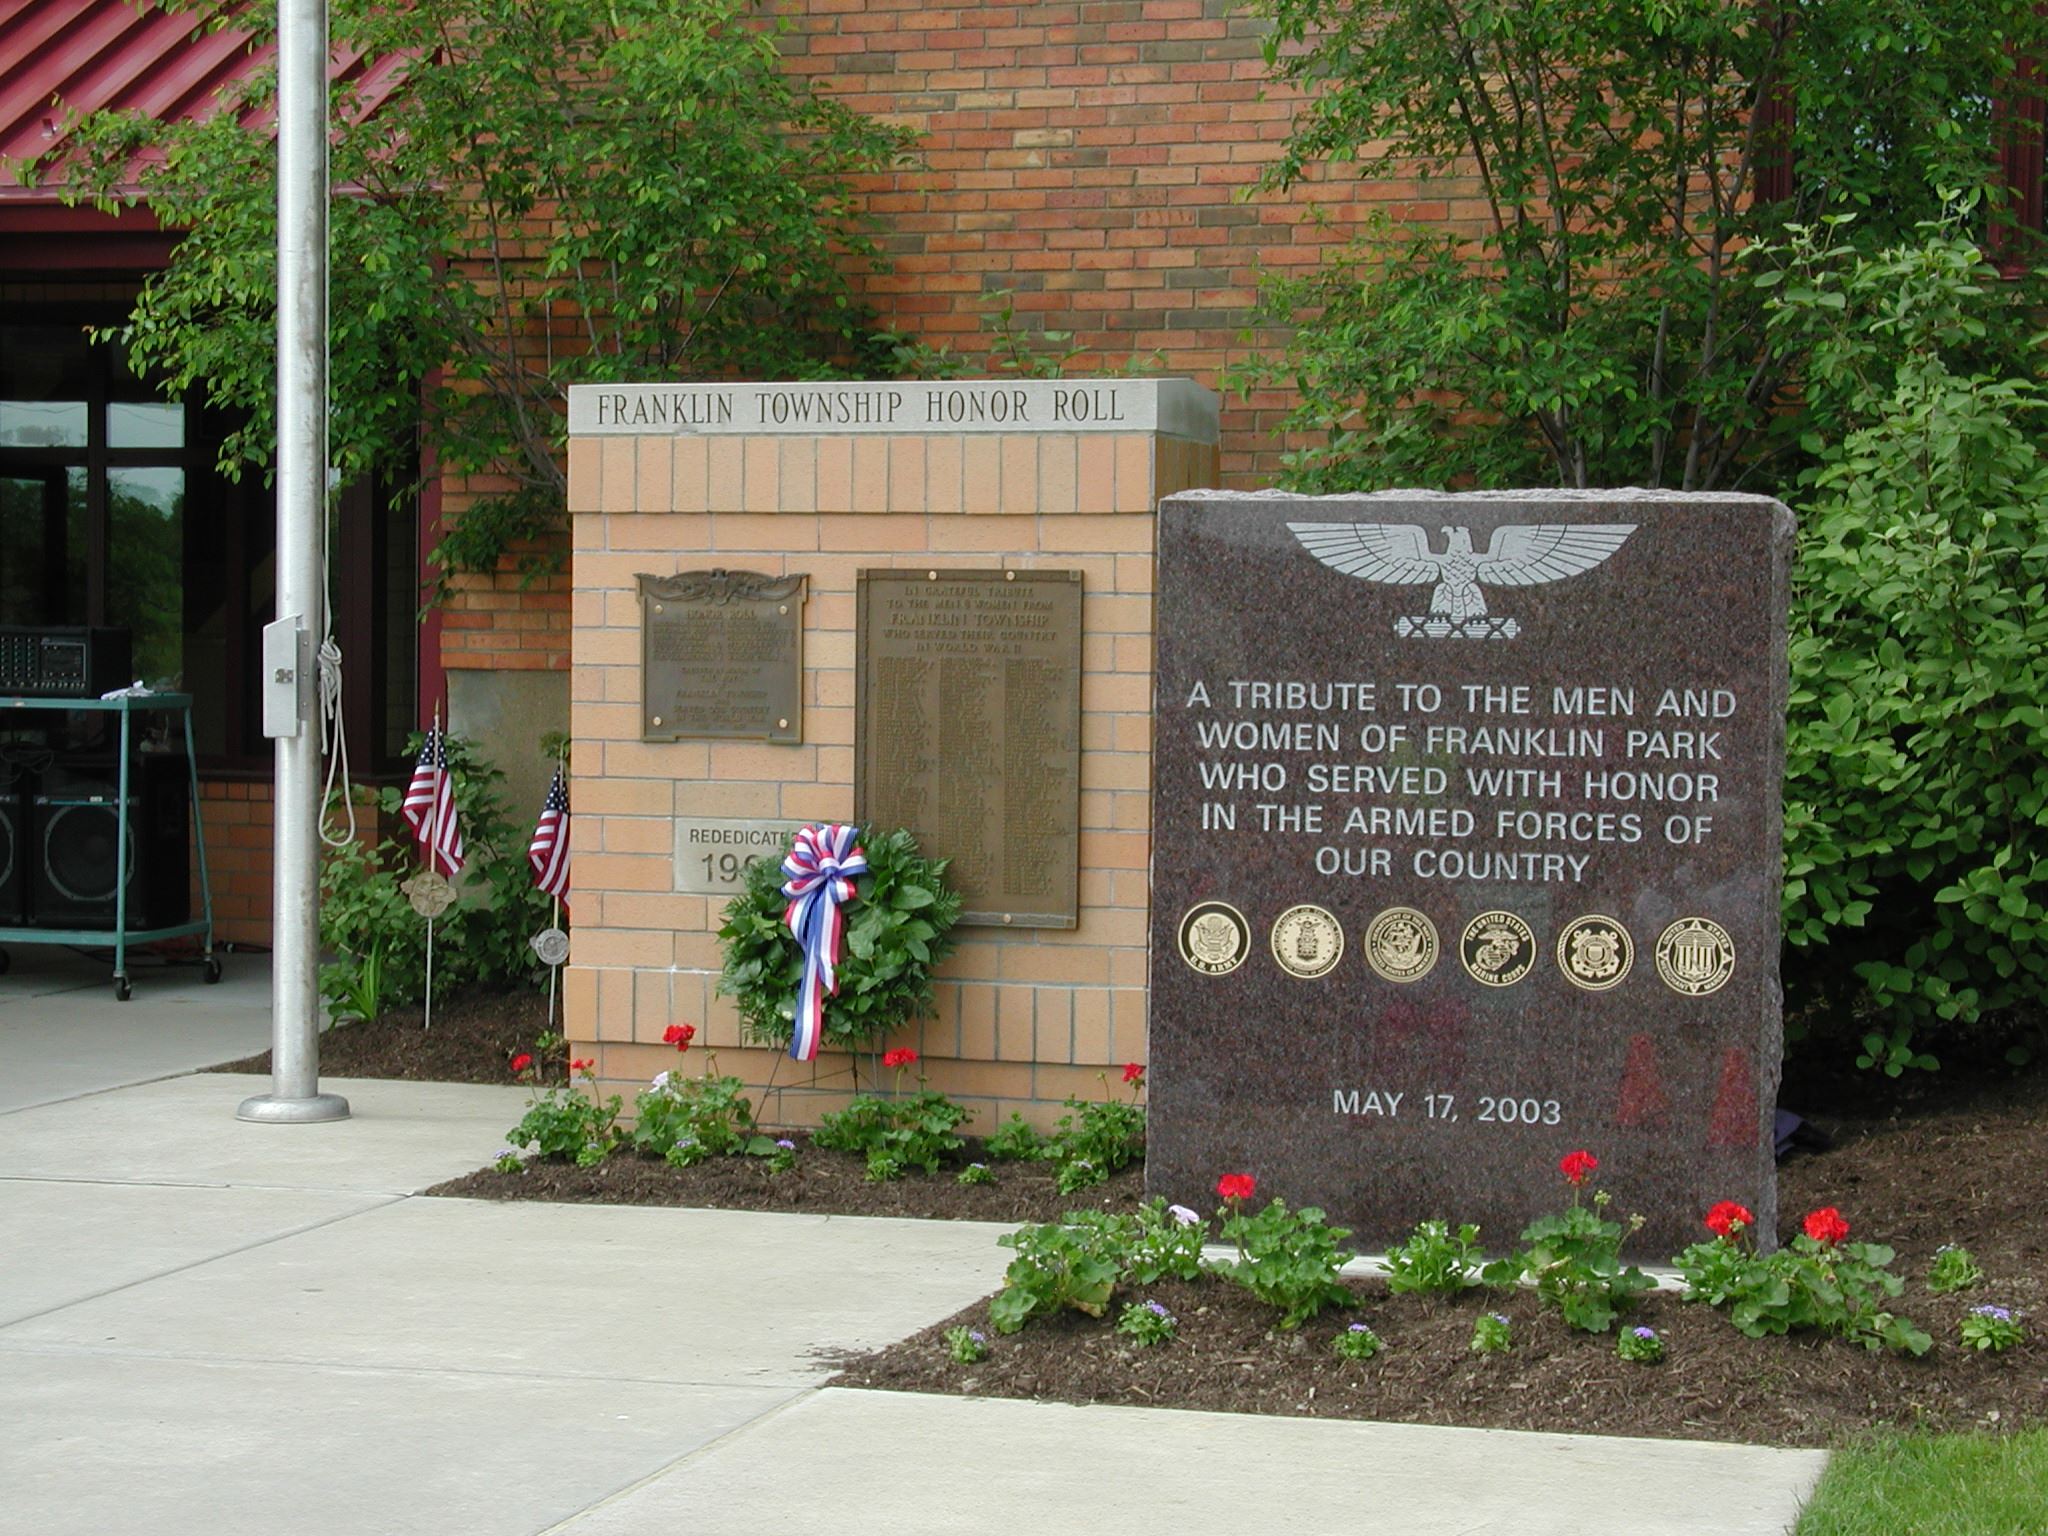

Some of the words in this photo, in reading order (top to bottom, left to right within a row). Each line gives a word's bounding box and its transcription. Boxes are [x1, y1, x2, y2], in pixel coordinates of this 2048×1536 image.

[599, 393, 732, 424] FRANKLIN
[755, 392, 901, 423] TOWNSHIP
[927, 390, 1029, 422] HONOR
[1054, 389, 1124, 421] ROLL
[974, 614, 1050, 628] TOWNSHIP
[1187, 682, 1210, 707] A
[1229, 682, 1375, 710] TRIBUTE
[1396, 685, 1441, 712] TO
[1462, 686, 1529, 713] THE
[1554, 688, 1633, 715] MEN
[1656, 690, 1735, 717] AND
[1199, 722, 1338, 751] WOMEN
[1362, 725, 1406, 752] OF
[1428, 727, 1602, 756] FRANKLIN
[1628, 731, 1720, 759] PARK
[1200, 763, 1285, 791] WHO
[1308, 765, 1446, 794] SERVED
[1468, 769, 1560, 797] WITH
[1586, 772, 1718, 801] HONOR
[1203, 803, 1234, 830] IN
[1256, 805, 1322, 832] THE
[1344, 807, 1473, 836] ARMED
[1499, 811, 1641, 842] FORCES
[1666, 816, 1712, 843] OF
[1316, 847, 1390, 875] OUR
[1415, 850, 1589, 881] COUNTRY
[1475, 914, 1506, 929] UNITED
[1505, 916, 1531, 942] STATES
[1707, 924, 1730, 950] STATES
[1209, 957, 1238, 972] ARMY
[1469, 962, 1500, 984] MARINE
[1501, 963, 1527, 984] CORPS
[1335, 1090, 1403, 1116] MAY
[1425, 1095, 1457, 1122] 17,
[1479, 1097, 1560, 1124] 2003
